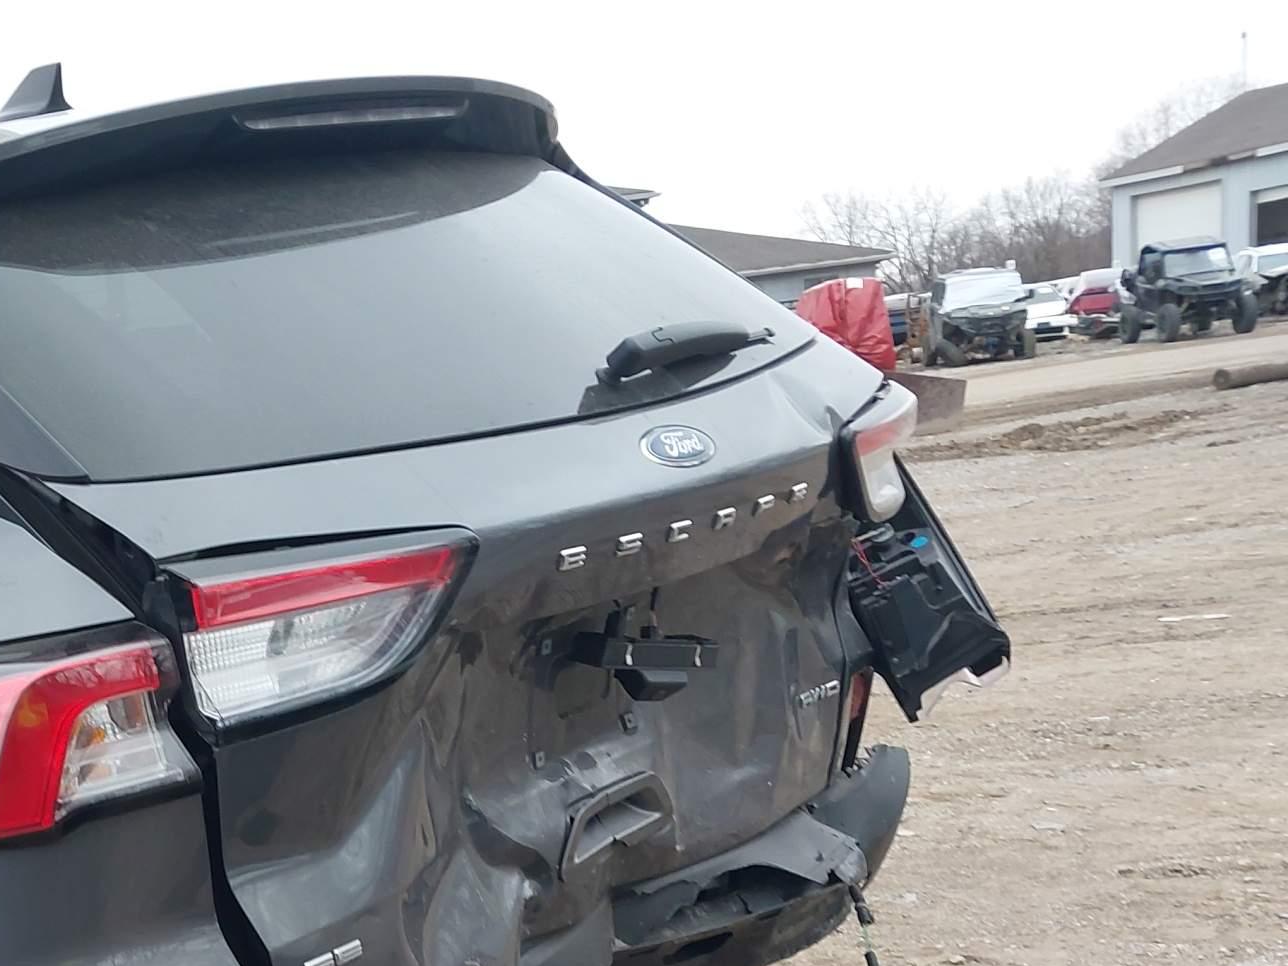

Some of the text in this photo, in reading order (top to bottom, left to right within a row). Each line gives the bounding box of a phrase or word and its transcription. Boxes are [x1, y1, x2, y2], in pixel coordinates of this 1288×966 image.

[659, 430, 706, 458] Ford
[557, 482, 809, 572] ESCAPE
[799, 679, 841, 709] FWD
